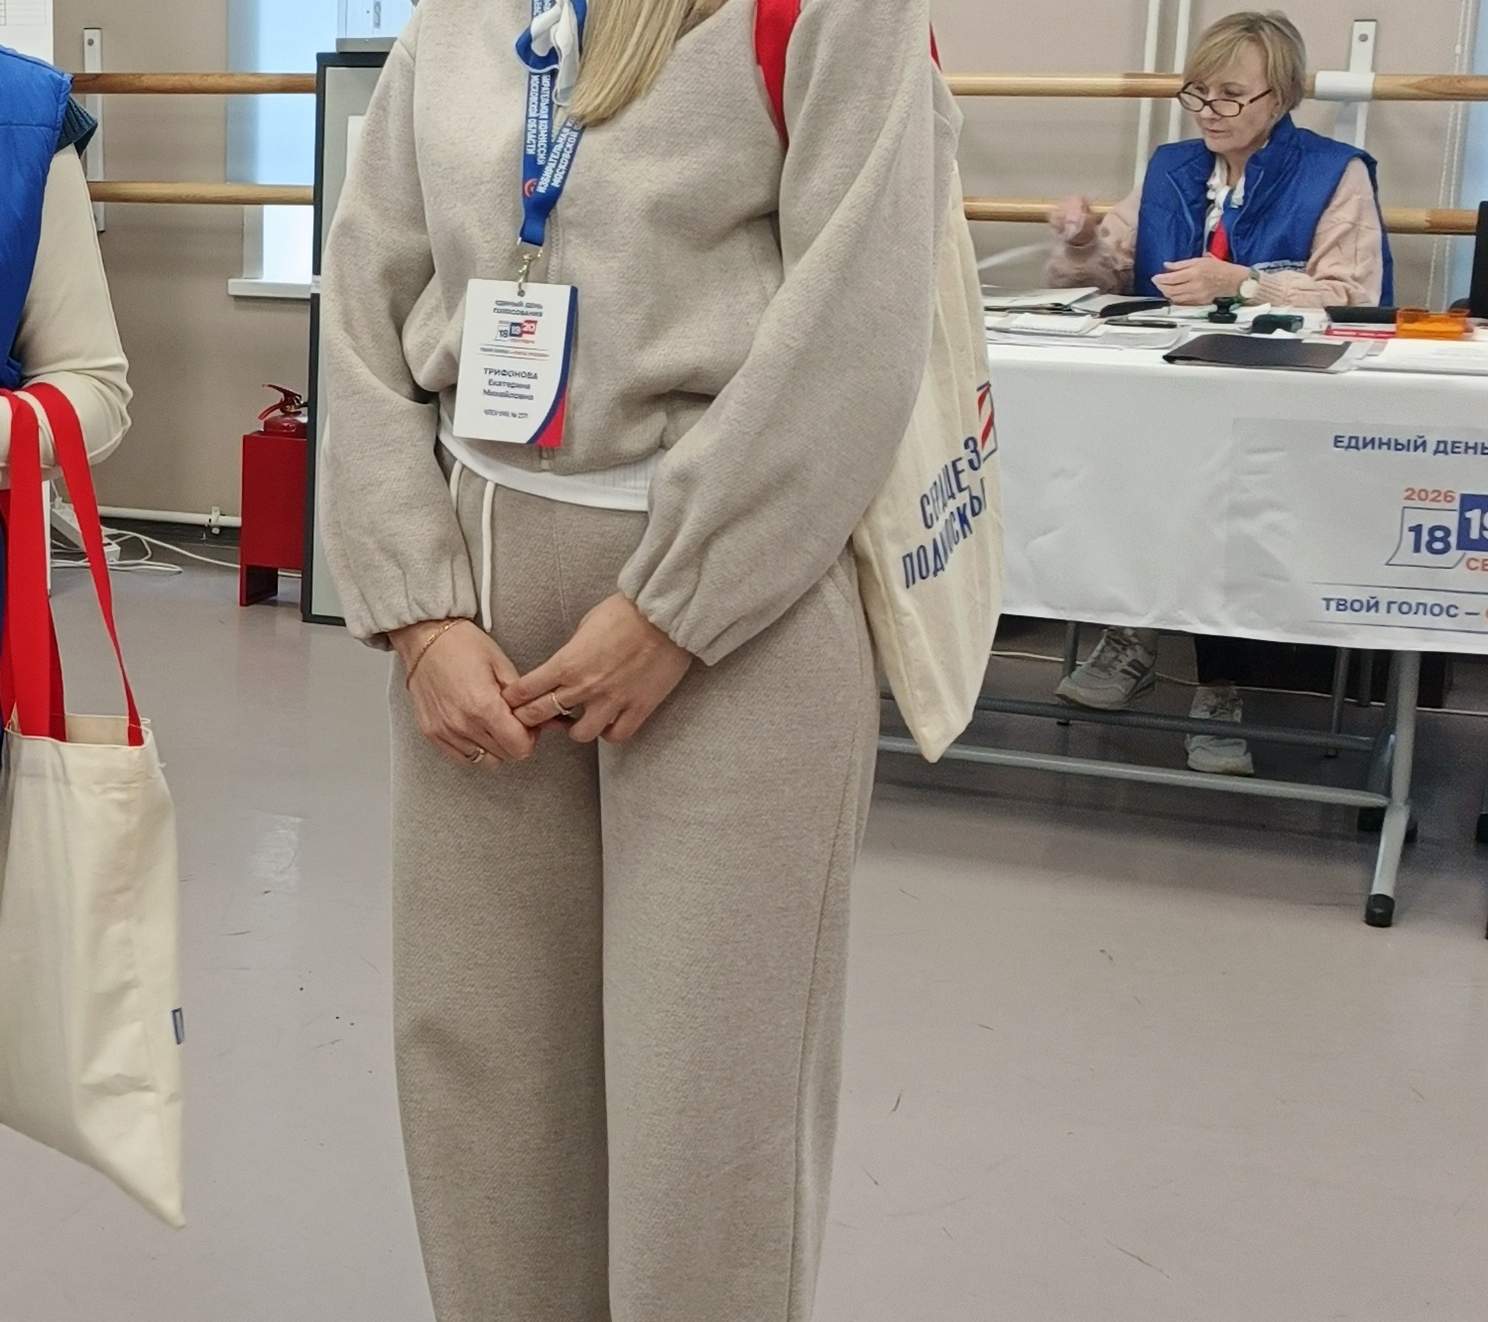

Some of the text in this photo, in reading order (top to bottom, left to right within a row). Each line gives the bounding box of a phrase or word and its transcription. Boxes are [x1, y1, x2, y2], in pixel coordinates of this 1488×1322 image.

[483, 367, 539, 380] ТРИФОНОВА
[1332, 434, 1428, 454] ЕДИНЫЙ
[1403, 487, 1456, 505] 2026
[1407, 508, 1488, 556] 18 1
[1321, 595, 1380, 614] ТВОЙ
[1385, 600, 1460, 618] ГОЛОС
